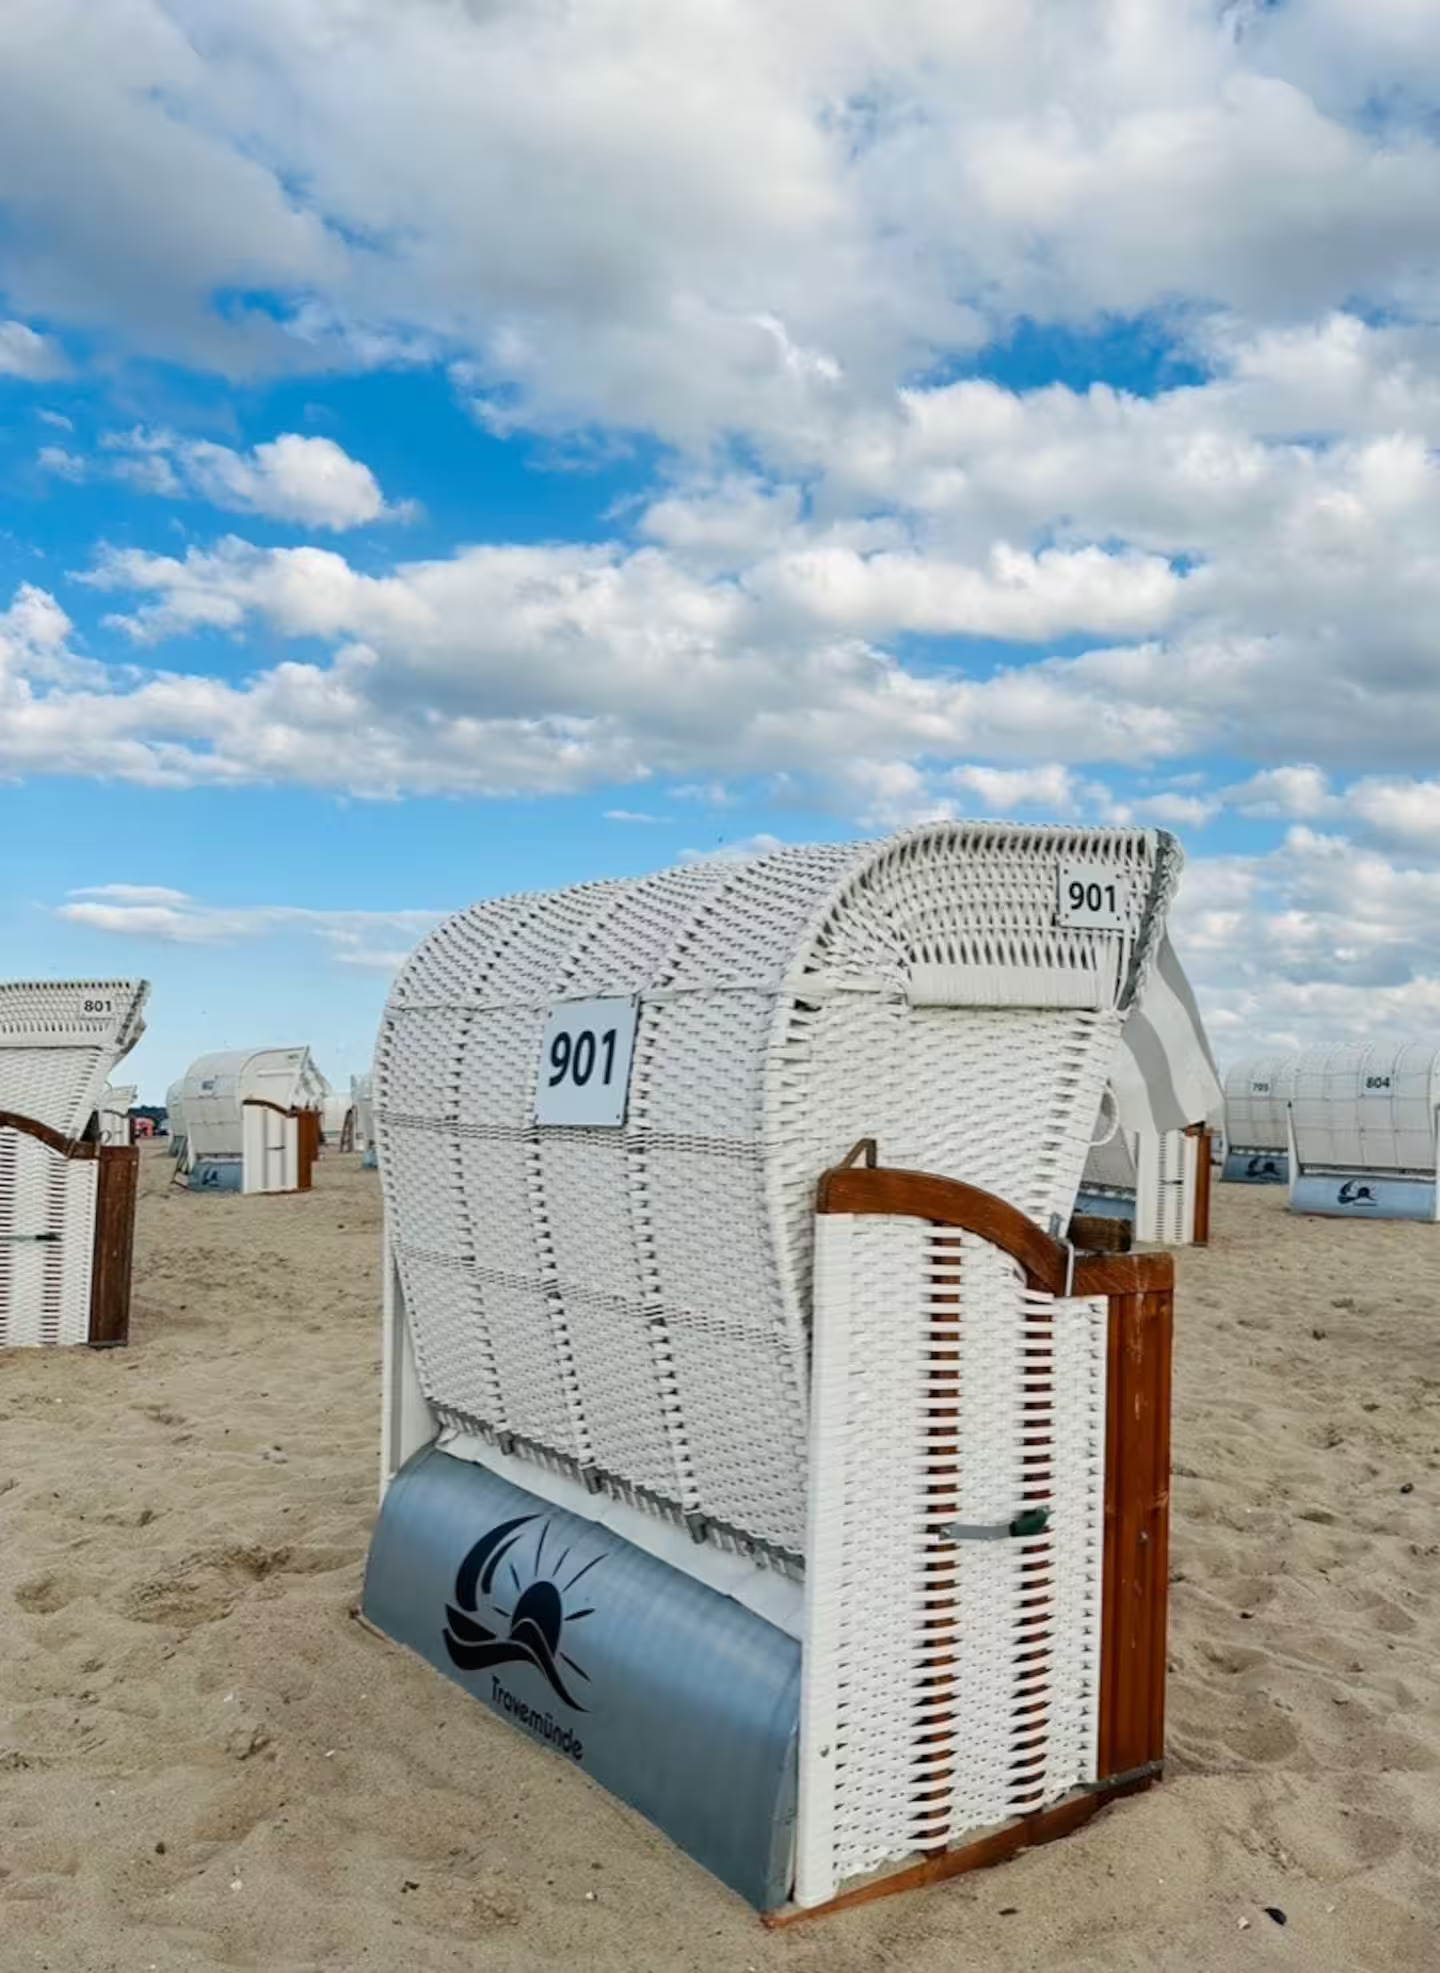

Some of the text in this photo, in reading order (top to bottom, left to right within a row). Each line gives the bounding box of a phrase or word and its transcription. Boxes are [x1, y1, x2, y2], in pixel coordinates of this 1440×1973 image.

[1069, 881, 1115, 913] 901
[84, 999, 112, 1012] 801
[547, 1028, 617, 1087] 901
[1366, 1076, 1390, 1089] 804
[491, 1674, 583, 1761] Travemünde
